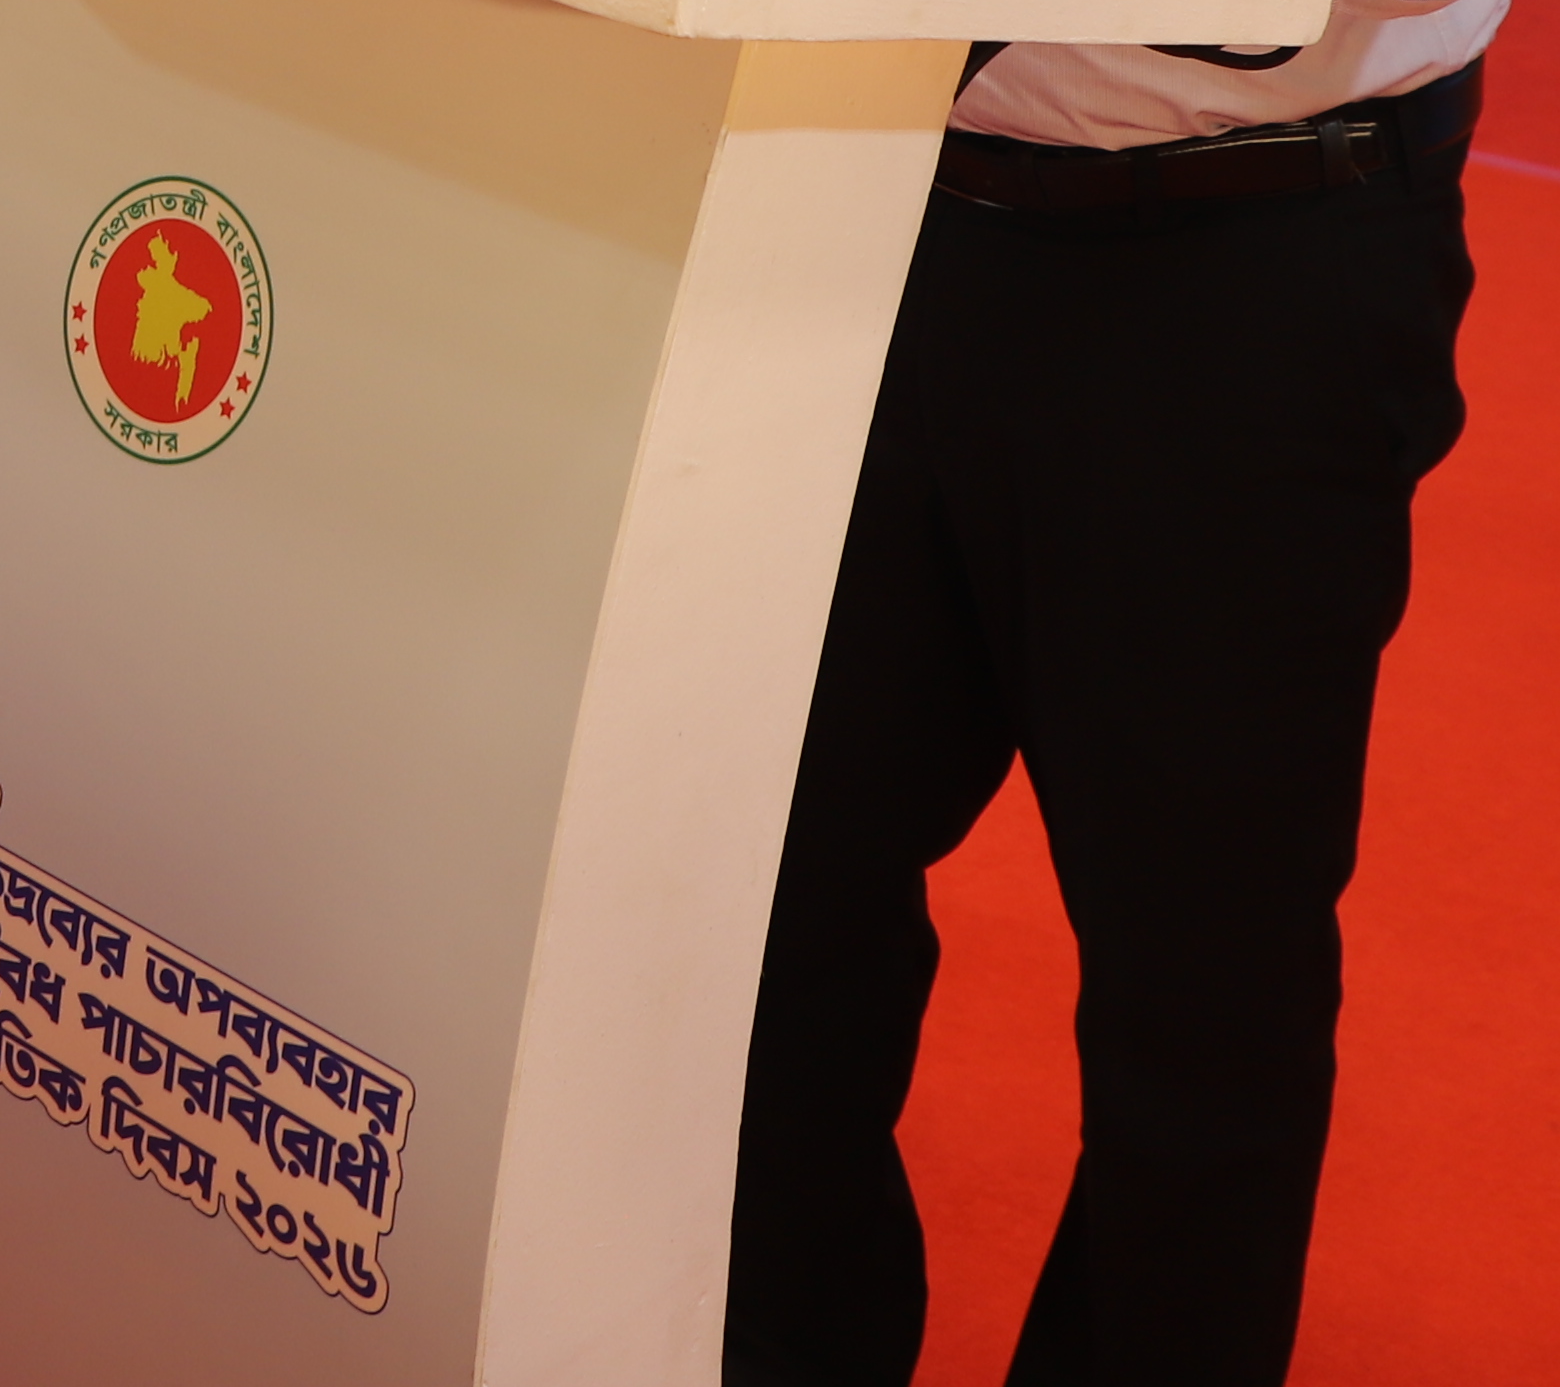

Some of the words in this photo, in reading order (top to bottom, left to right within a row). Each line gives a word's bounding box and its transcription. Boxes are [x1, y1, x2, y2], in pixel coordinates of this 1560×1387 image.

[90, 188, 208, 270] গণপ্রজাতন্ত্রী
[216, 212, 264, 359] বাংলাদেশ
[104, 399, 179, 453] সরকার
[78, 991, 391, 1218] পাচারবিরোধী
[145, 945, 404, 1137] অপব্যবহার
[100, 1079, 217, 1202] দিবস
[234, 1170, 378, 1300] ২০২৬
